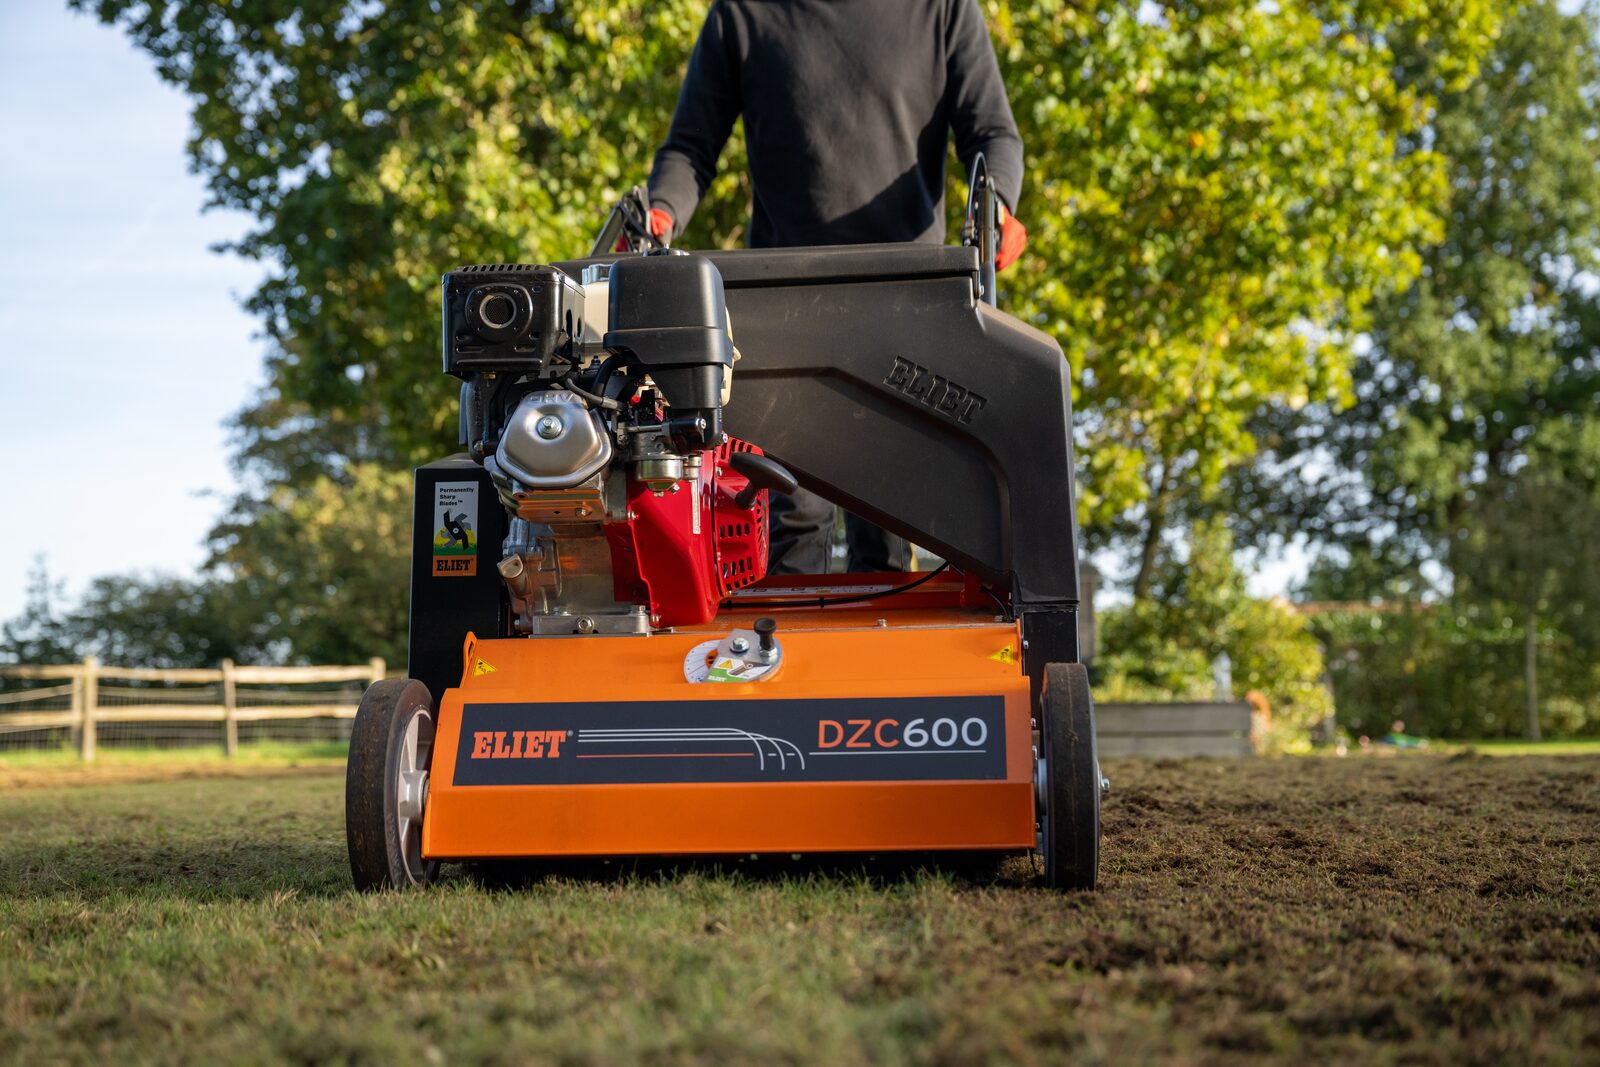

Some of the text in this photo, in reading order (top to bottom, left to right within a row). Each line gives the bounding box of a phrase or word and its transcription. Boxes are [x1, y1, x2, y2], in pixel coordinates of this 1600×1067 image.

[883, 356, 987, 424] ELIET
[436, 560, 471, 571] ELIET
[818, 717, 988, 748] DZC600
